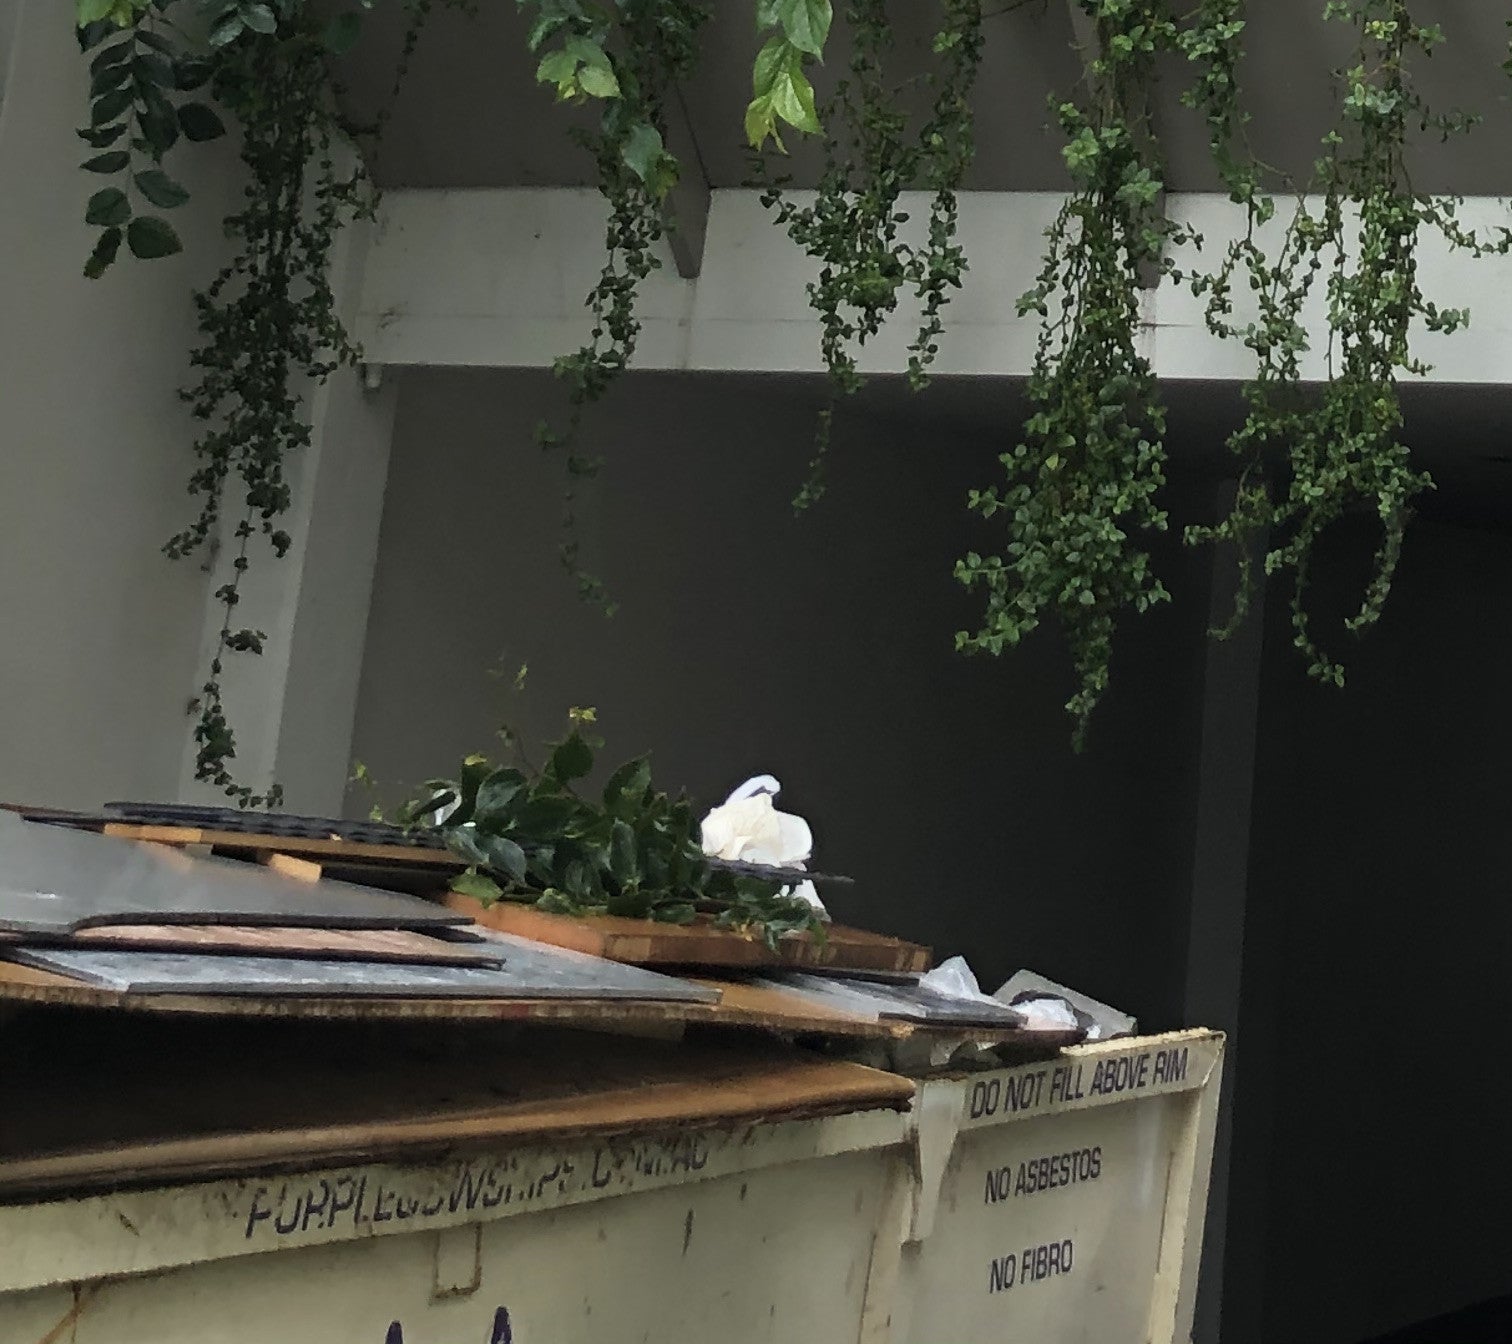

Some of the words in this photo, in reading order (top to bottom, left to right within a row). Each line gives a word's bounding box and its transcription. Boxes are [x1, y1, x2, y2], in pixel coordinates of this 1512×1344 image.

[970, 1081, 1001, 1119] DO
[1004, 1070, 1047, 1113] NOT
[1050, 1064, 1085, 1105] FILL
[1090, 1053, 1151, 1097] ABOVE
[1153, 1046, 1189, 1086] RIM
[984, 1167, 1012, 1205] NO
[1014, 1146, 1102, 1197] ASBESTOS
[989, 1253, 1017, 1295] NO
[1020, 1239, 1074, 1285] FIBRO
